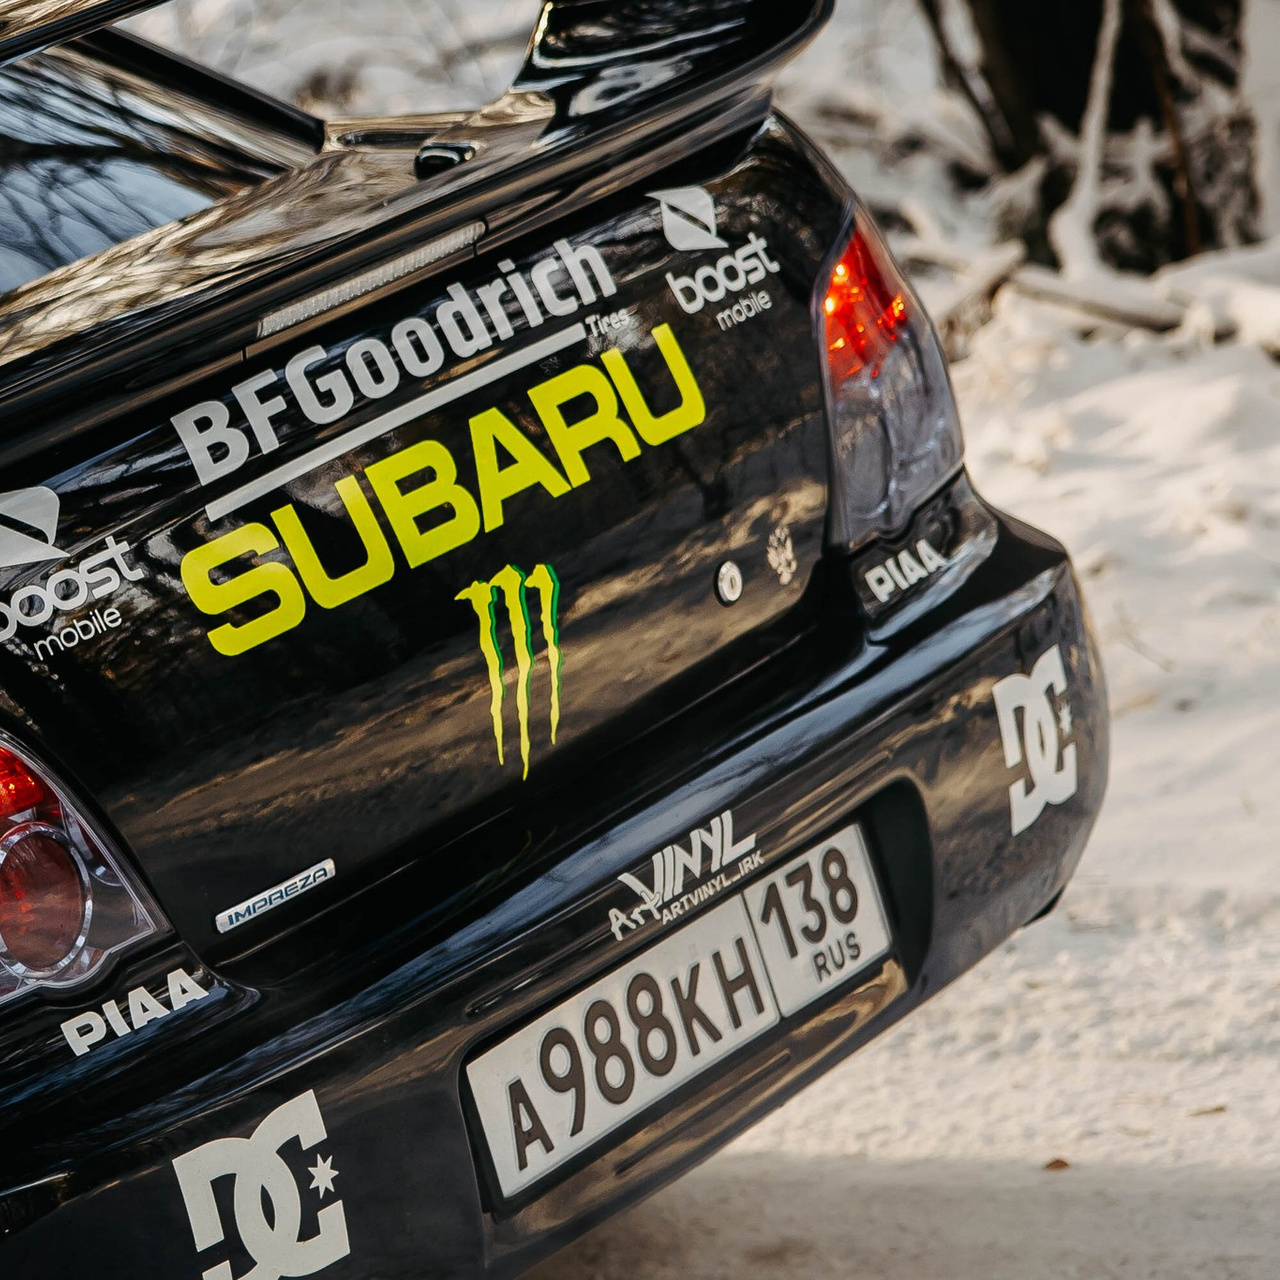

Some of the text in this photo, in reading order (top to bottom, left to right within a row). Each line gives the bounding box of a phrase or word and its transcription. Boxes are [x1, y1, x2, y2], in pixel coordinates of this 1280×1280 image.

[665, 231, 780, 314] boost
[584, 308, 631, 338] Tires
[716, 289, 773, 331] mobile
[170, 238, 618, 487] BFGoodrich
[180, 322, 707, 658] SUBARU
[864, 538, 949, 604] PIAA
[33, 607, 122, 662] mobile
[991, 643, 1078, 837] DC
[227, 866, 329, 927] IMPREZA
[760, 847, 859, 959] 138
[813, 931, 861, 982] RUS
[60, 968, 210, 1057] PIAA
